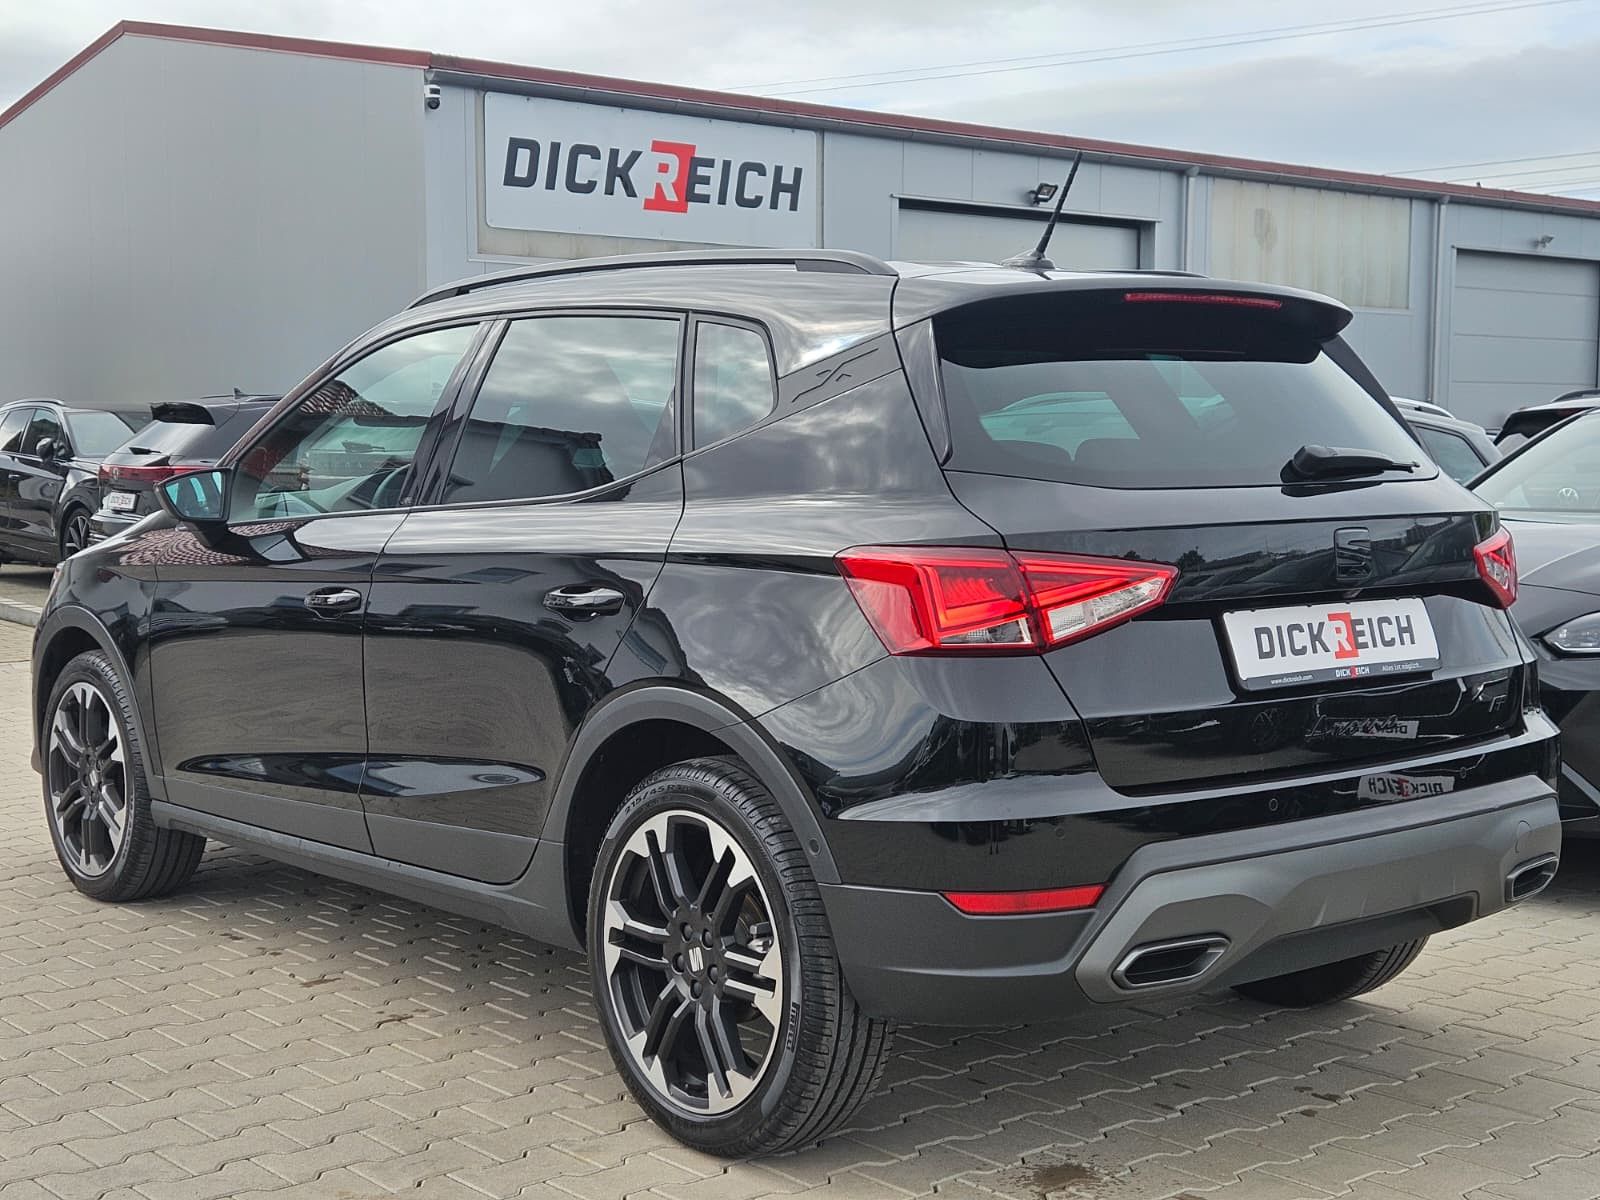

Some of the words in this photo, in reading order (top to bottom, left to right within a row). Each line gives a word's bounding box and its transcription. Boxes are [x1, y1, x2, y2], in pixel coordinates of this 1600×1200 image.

[503, 137, 802, 214] DICKREICH
[1254, 612, 1416, 660] DICKREICH
[1335, 665, 1370, 679] DICKREICH
